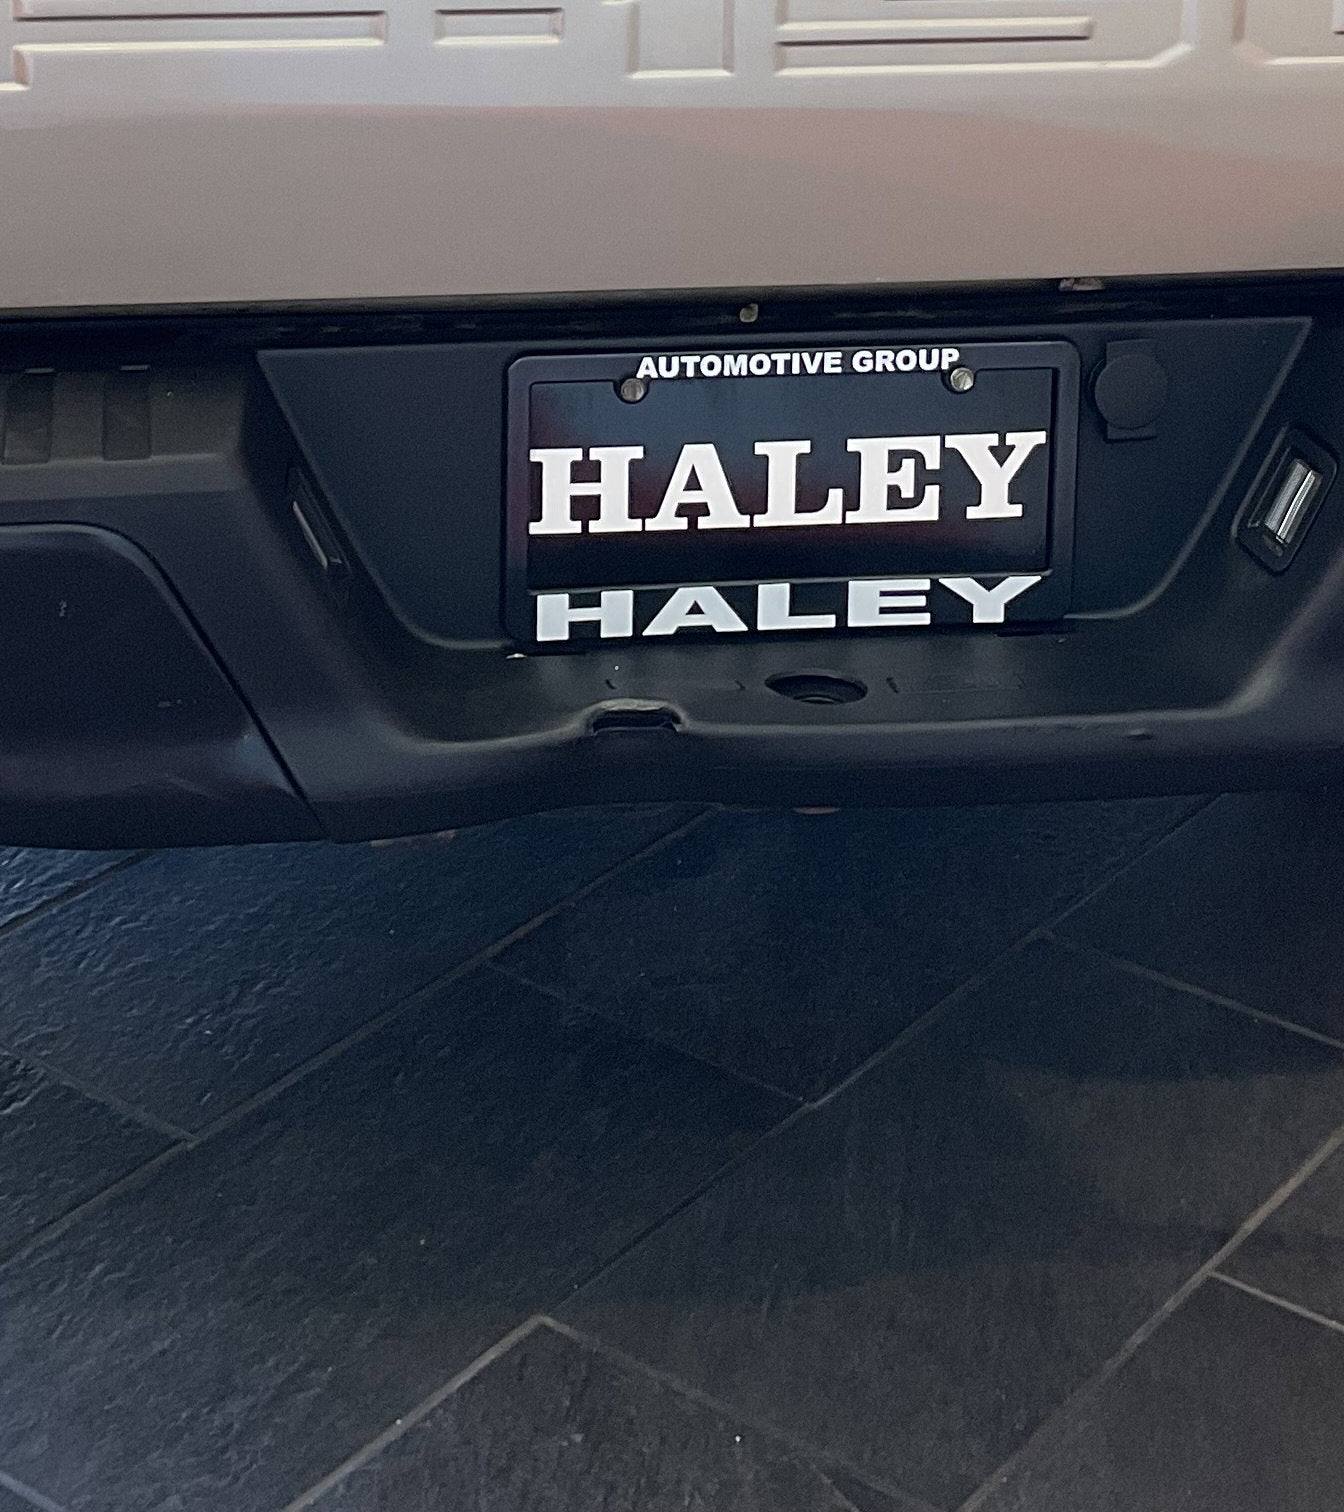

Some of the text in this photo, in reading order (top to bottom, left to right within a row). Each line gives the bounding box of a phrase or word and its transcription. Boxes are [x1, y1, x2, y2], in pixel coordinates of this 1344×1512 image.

[636, 347, 960, 380] AUTOMOTIVE GROUP
[528, 430, 1047, 535] HALEY
[536, 575, 1042, 642] HALEY
